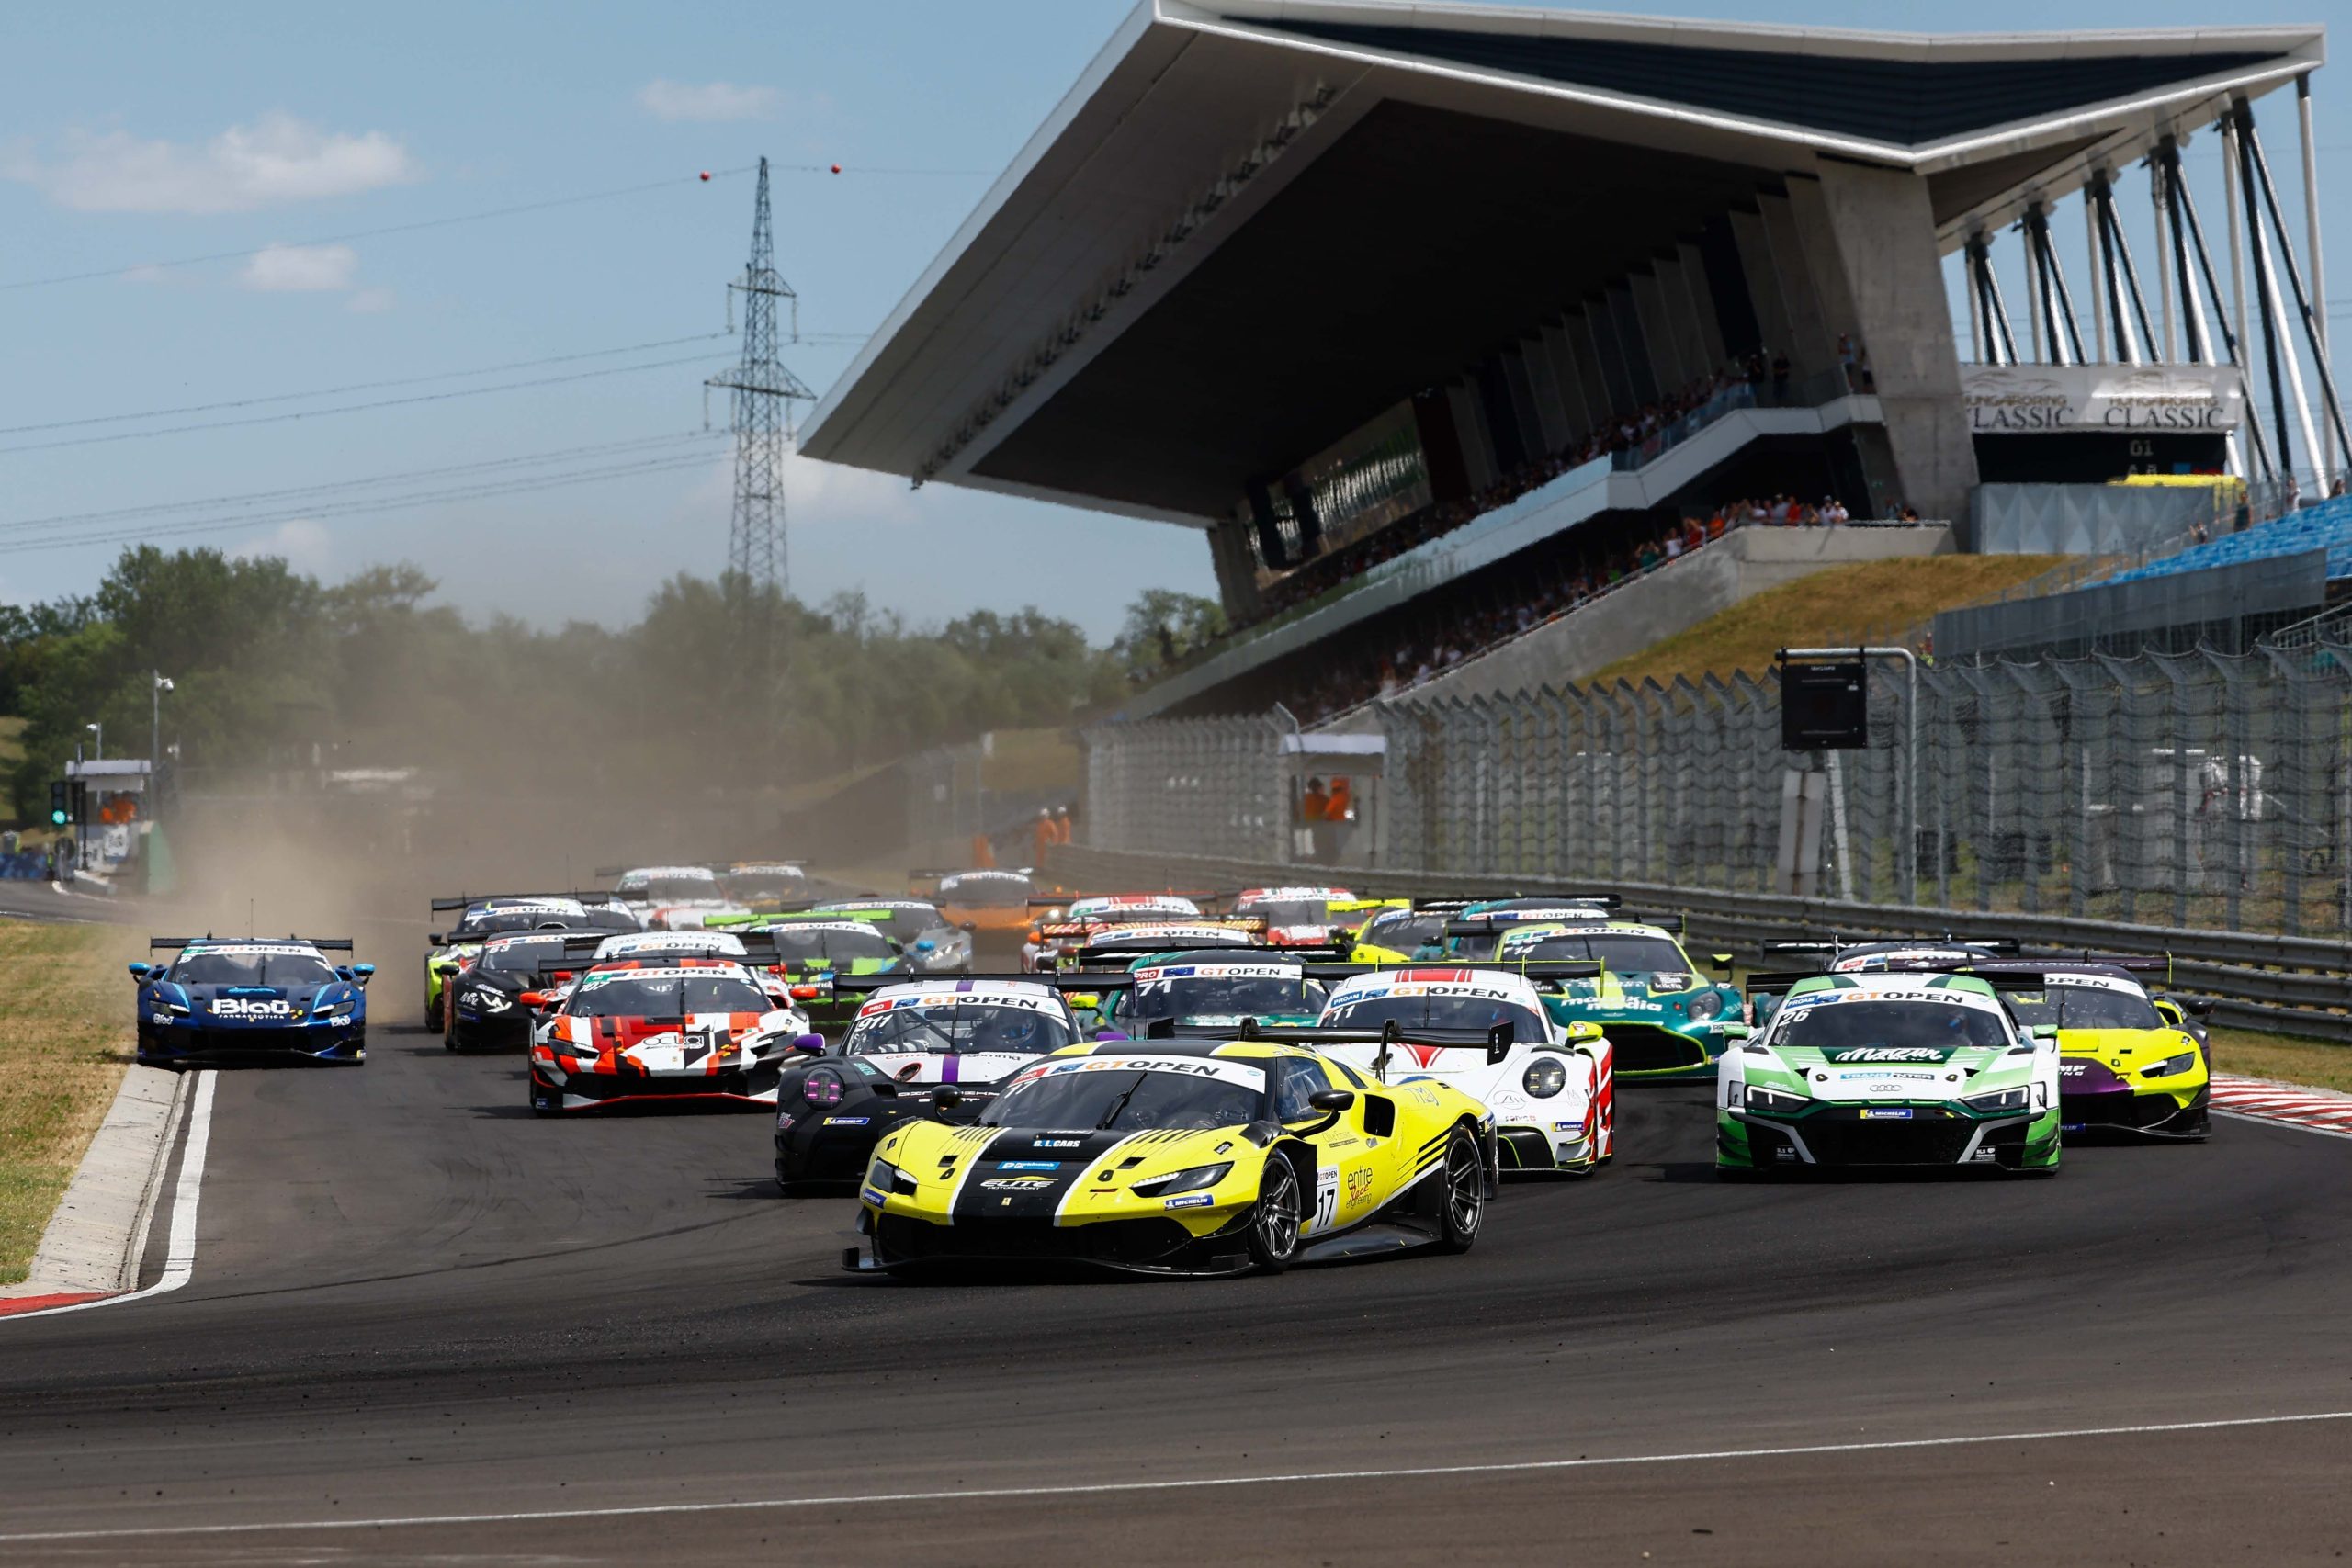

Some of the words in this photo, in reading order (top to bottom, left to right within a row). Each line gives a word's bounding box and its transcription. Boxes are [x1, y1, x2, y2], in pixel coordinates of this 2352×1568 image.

[1968, 407, 2074, 428] LASSIC
[2104, 407, 2224, 428] CLASSIC
[632, 968, 728, 976] GTOPEN
[1135, 970, 1157, 980] PRO
[1200, 967, 1281, 976] GTOPEN
[579, 981, 611, 993] 107
[1137, 980, 1173, 997] 71
[1393, 987, 1509, 999] GTOPEN
[923, 997, 1039, 1010] GTOPEN
[1333, 993, 1361, 1006] PROAM
[1787, 997, 1815, 1007] PROAM
[1846, 991, 1964, 1003] GTOPEN
[868, 1002, 885, 1012] PRO
[1333, 1005, 1355, 1021] 11
[856, 1014, 893, 1032] 911
[1778, 1009, 1812, 1028] 26
[1085, 1059, 1220, 1077] GTOPEN
[1004, 1078, 1039, 1099] 17
[1347, 1165, 1373, 1190] entire
[1175, 1198, 1208, 1206] MICHELIN
[1317, 1189, 1336, 1228] 17
